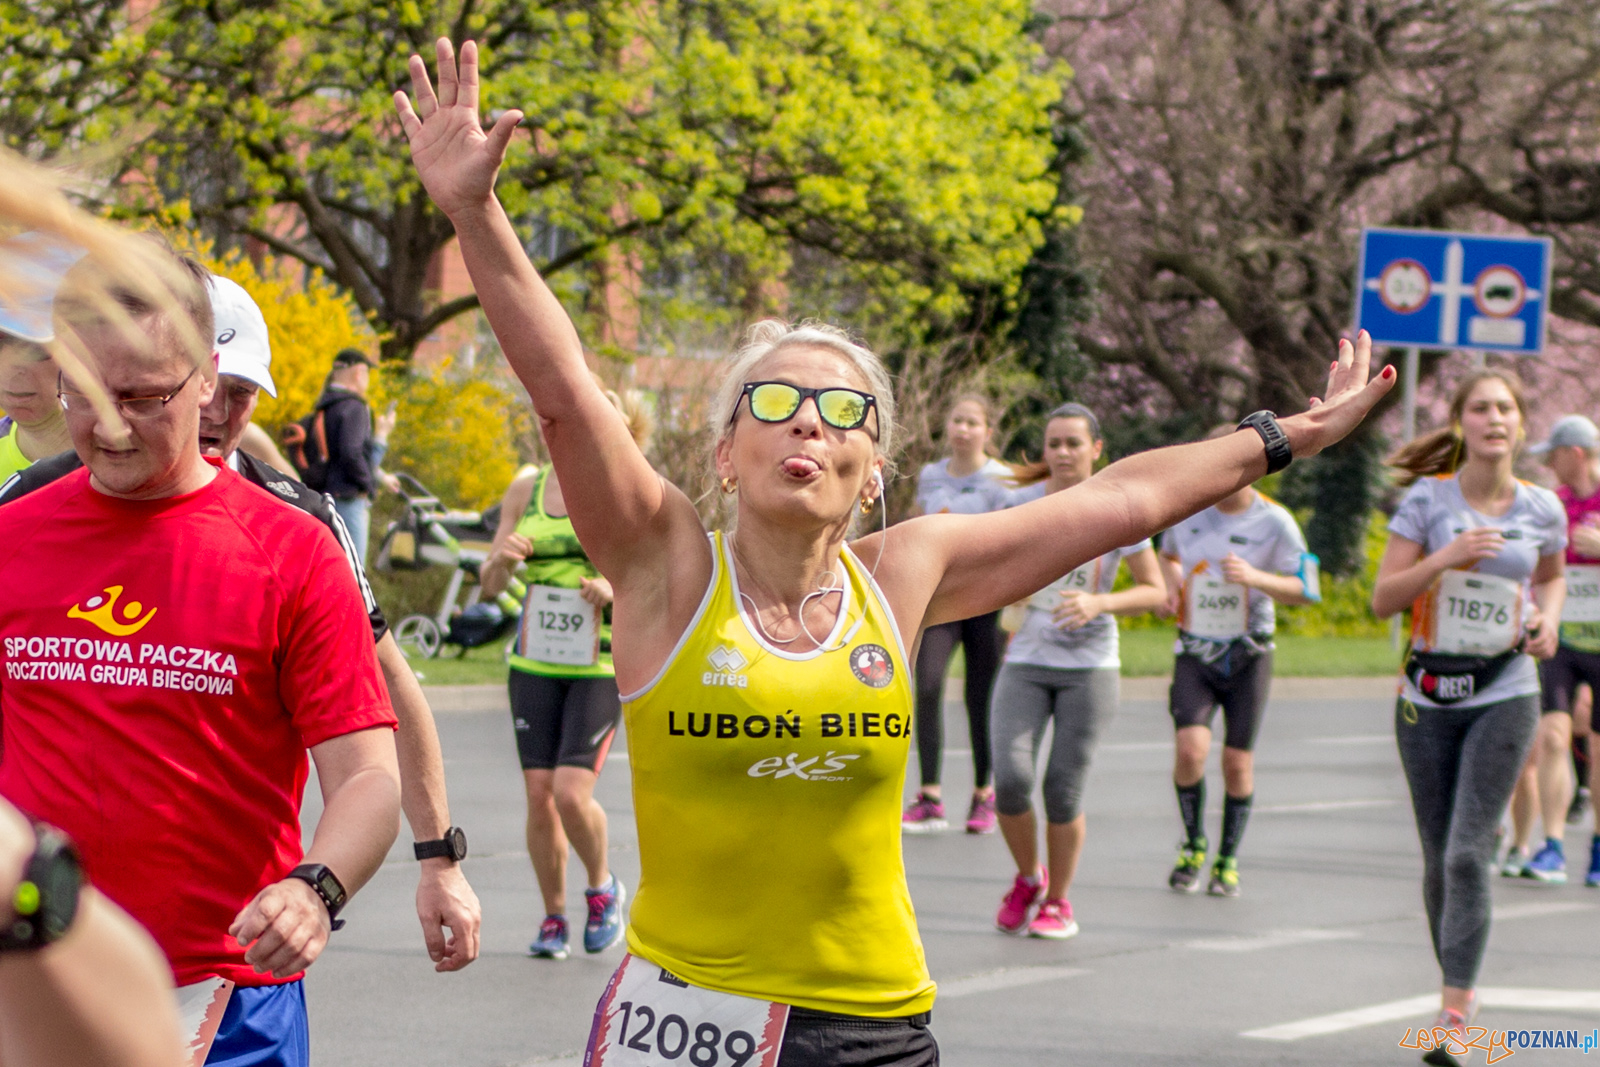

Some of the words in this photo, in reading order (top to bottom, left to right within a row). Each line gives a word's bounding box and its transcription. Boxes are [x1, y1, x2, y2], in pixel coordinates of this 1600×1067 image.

[1197, 594, 1240, 610] 2499
[1448, 597, 1509, 625] 11876
[538, 610, 585, 633] 1239
[3, 636, 134, 663] SPORTOWA
[138, 643, 239, 676] PACZKA
[5, 661, 87, 681] POCZTOWA
[90, 664, 149, 687] GRUPA
[151, 668, 234, 696] BIEGOWA
[668, 709, 801, 739] LUBOŃ
[618, 1001, 756, 1067] 12089
